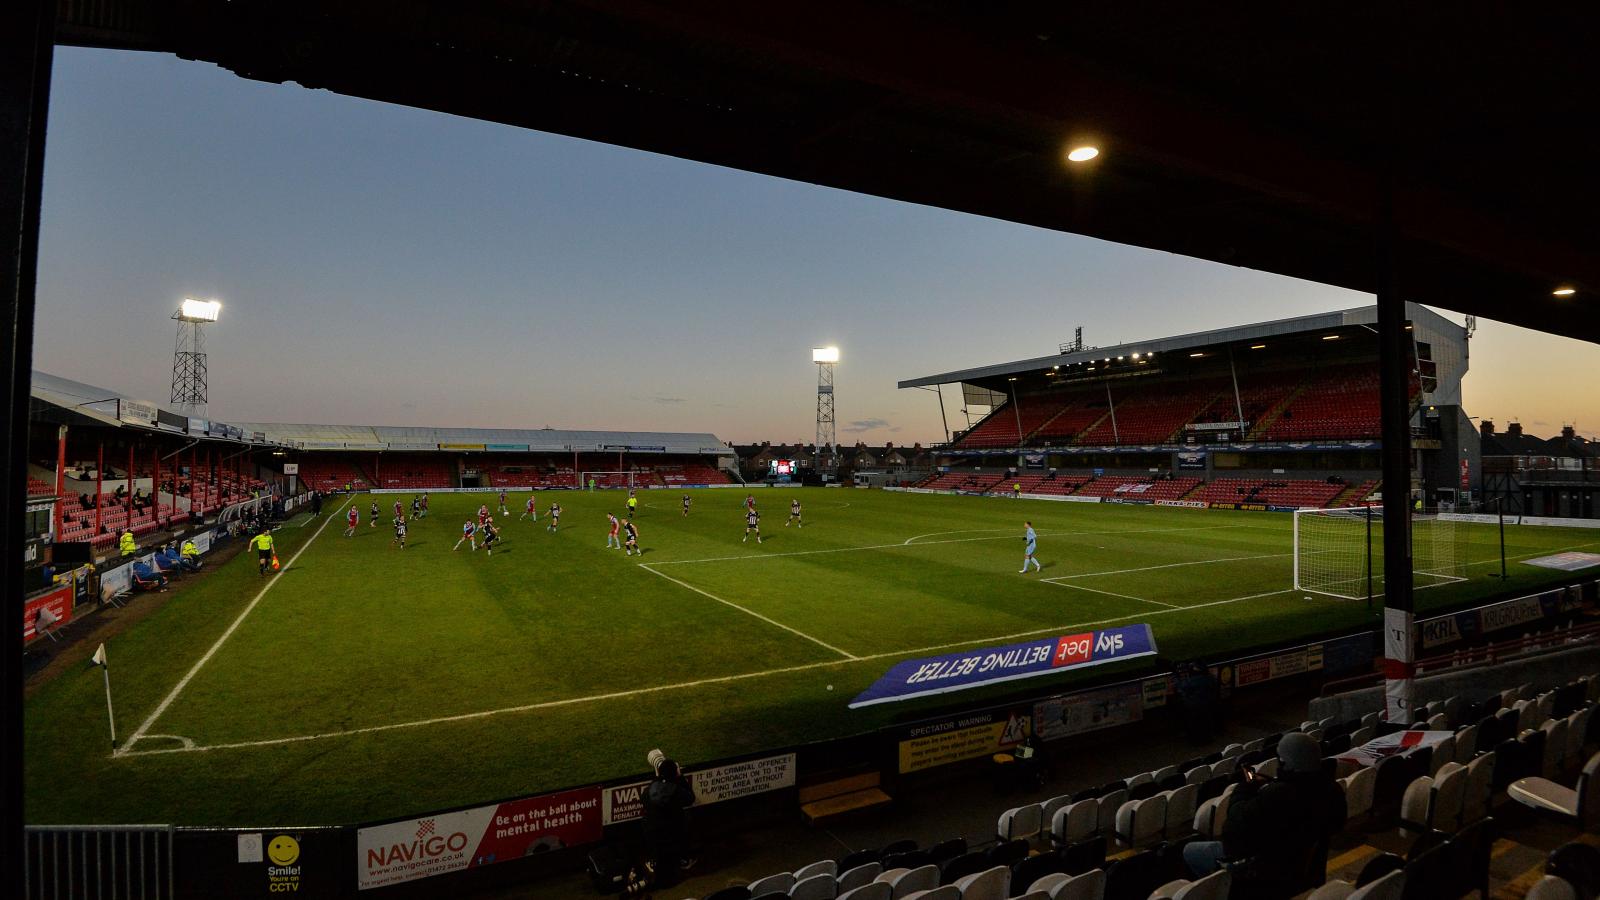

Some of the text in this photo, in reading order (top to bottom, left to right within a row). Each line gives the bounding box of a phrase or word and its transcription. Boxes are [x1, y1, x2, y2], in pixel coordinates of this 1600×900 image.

[1430, 616, 1457, 641] KRL
[907, 632, 1124, 684] sky bet BETTING BETTER
[910, 714, 993, 737] SPECTATOR WARNING
[711, 771, 748, 786] ENCROACH
[750, 770, 760, 778] ON
[763, 767, 772, 775] TO
[774, 764, 787, 773] THE
[724, 763, 756, 775] CRIMINAL
[701, 772, 785, 795] PLAYING AREA WITHOUT
[496, 798, 598, 826] Be on the ball about
[613, 803, 644, 814] MAXIMUM
[613, 810, 642, 822] PENALTY
[496, 812, 583, 839] mental health
[267, 865, 301, 876] Smile!
[369, 852, 465, 877] www.navigocare.co.uk
[269, 882, 299, 892] CCTV
